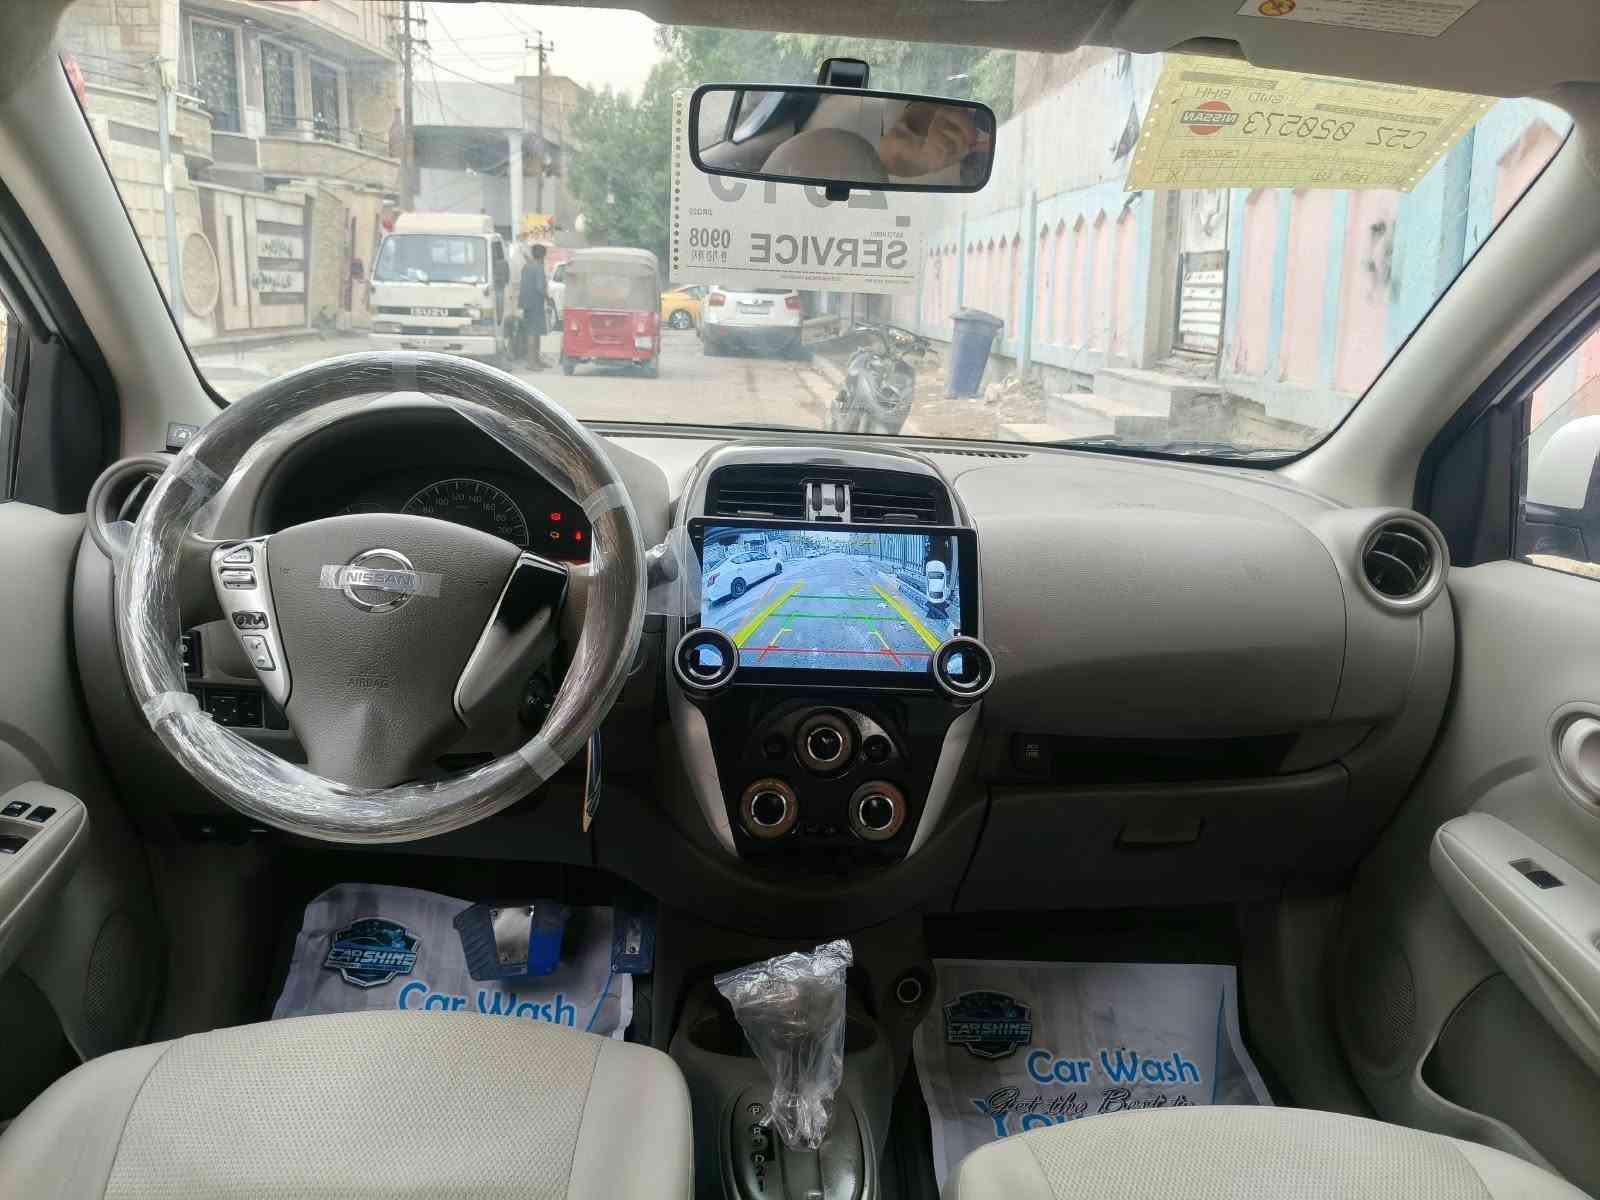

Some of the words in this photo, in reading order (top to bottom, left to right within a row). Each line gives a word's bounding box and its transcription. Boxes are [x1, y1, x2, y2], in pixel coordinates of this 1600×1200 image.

[346, 570, 416, 589] NISSAN
[398, 981, 466, 1011] Car
[477, 989, 576, 1027] Wash
[1026, 1050, 1090, 1083] Car
[1100, 1050, 1199, 1083] Wash
[989, 1088, 1043, 1114] Get
[1048, 1091, 1088, 1114] the
